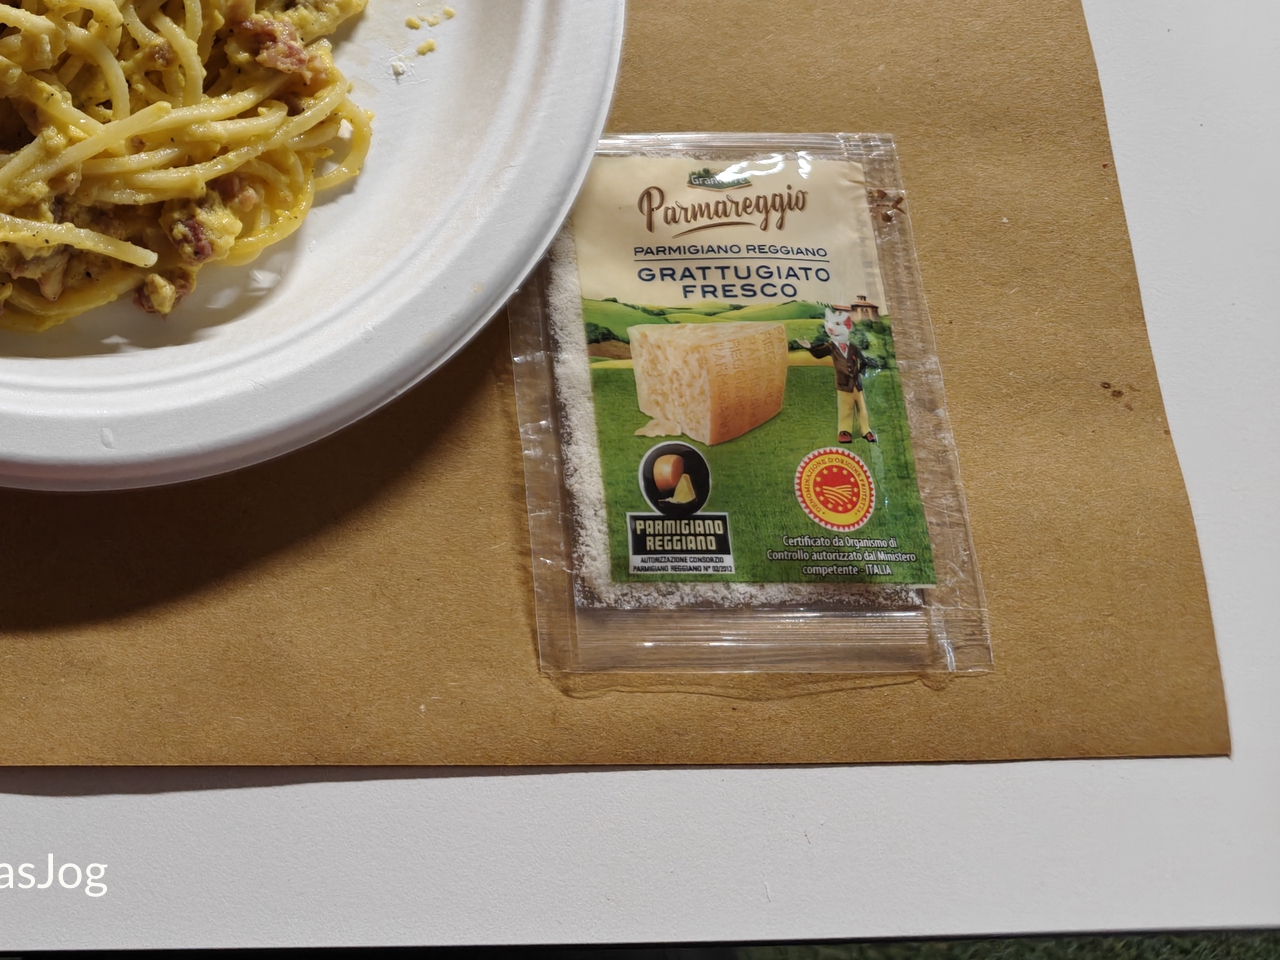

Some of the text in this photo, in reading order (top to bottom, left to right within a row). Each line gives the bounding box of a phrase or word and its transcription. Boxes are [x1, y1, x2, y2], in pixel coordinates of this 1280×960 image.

[637, 184, 808, 233] Parmareggio
[634, 244, 828, 257] PARMIGIANO REGGIANO
[637, 265, 830, 282] GRATTUGIATO
[682, 283, 798, 299] FRESCO
[636, 520, 724, 534] PARMIGIANO
[646, 536, 716, 550] REGGIANO
[783, 535, 897, 549] Certificato da Organismo di
[767, 550, 916, 562] Controllo autorizzato dal Ministero
[802, 566, 858, 576] competente
[865, 564, 892, 575] ITALIA
